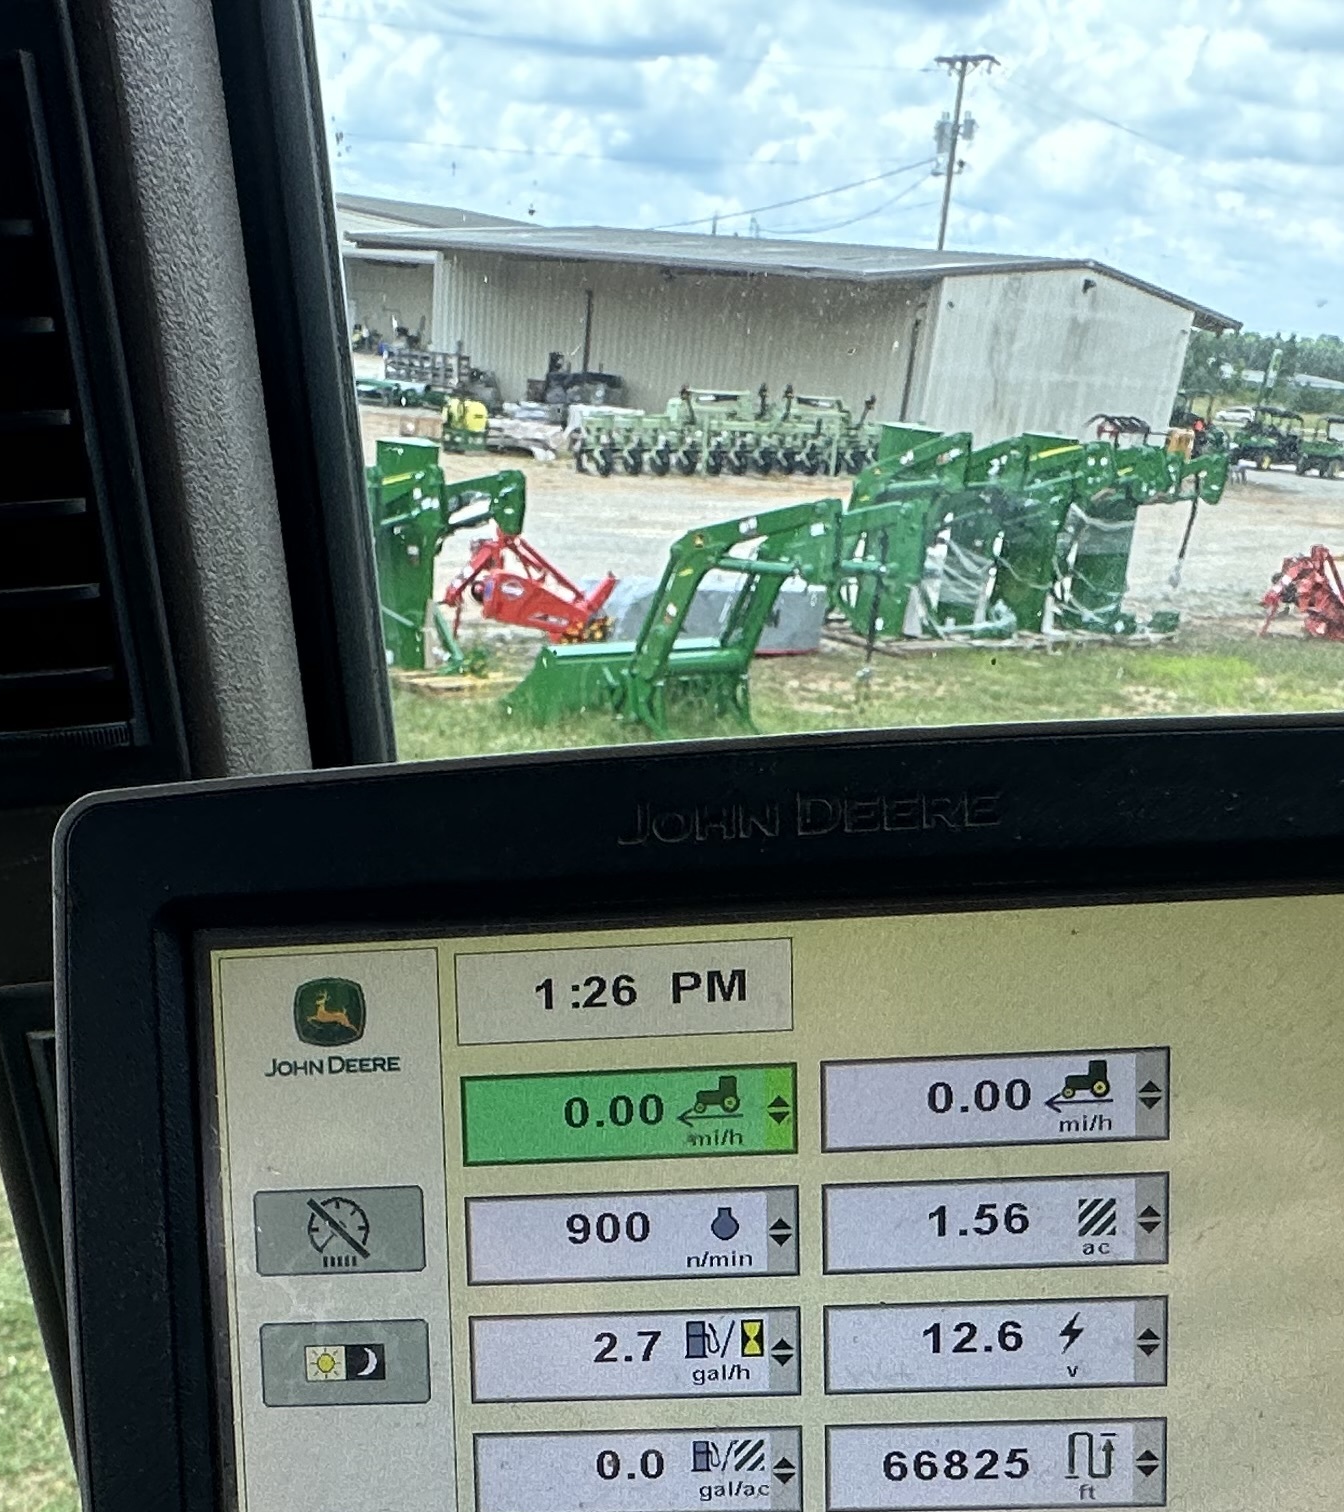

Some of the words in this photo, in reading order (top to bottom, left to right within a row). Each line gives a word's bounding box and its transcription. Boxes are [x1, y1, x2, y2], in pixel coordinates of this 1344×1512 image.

[617, 802, 780, 846] JOHN
[796, 790, 1002, 837] DEERE
[534, 974, 638, 1011] 1:26
[671, 968, 748, 1005] PM
[264, 1058, 324, 1078] JOHN
[327, 1055, 401, 1075] DEERE
[564, 1093, 665, 1129] 0.00
[926, 1078, 1032, 1114] 0.00
[690, 1129, 744, 1147] mi/h
[1058, 1113, 1113, 1133] mi/h
[565, 1210, 651, 1245] 900
[928, 1201, 1030, 1237] 1.56
[686, 1250, 754, 1269] n/min
[1081, 1242, 1111, 1256] ac
[593, 1330, 662, 1363] 2.7
[922, 1320, 1024, 1354] 12.6
[692, 1364, 751, 1386] gal/h
[596, 1448, 665, 1480] 0.0
[882, 1447, 1030, 1482] 66825
[698, 1480, 770, 1502] gal/ac
[1078, 1483, 1097, 1501] ft
